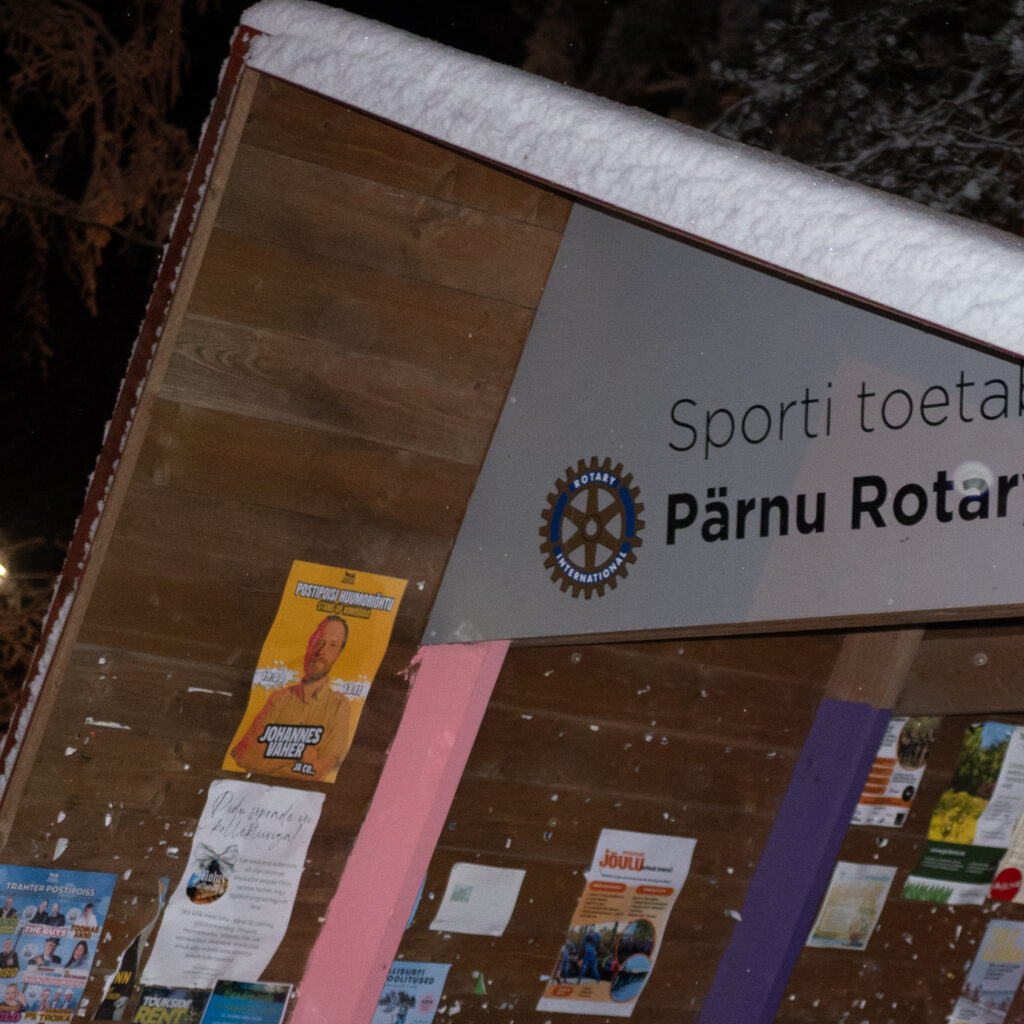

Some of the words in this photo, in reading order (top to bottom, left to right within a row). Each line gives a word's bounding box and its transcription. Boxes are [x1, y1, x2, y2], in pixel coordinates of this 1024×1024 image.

[668, 382, 832, 460] Sporti
[573, 472, 617, 489] ROTARY
[666, 486, 826, 546] Pärnu
[556, 552, 628, 584] INTERNATIONAL
[258, 725, 324, 744] JOHANNES
[265, 742, 306, 758] VAHER
[6, 882, 45, 893] TRAHTER
[45, 885, 96, 897] POSTIPOISS
[386, 975, 435, 985] OOLITUSED
[133, 1006, 189, 1024] RENT
